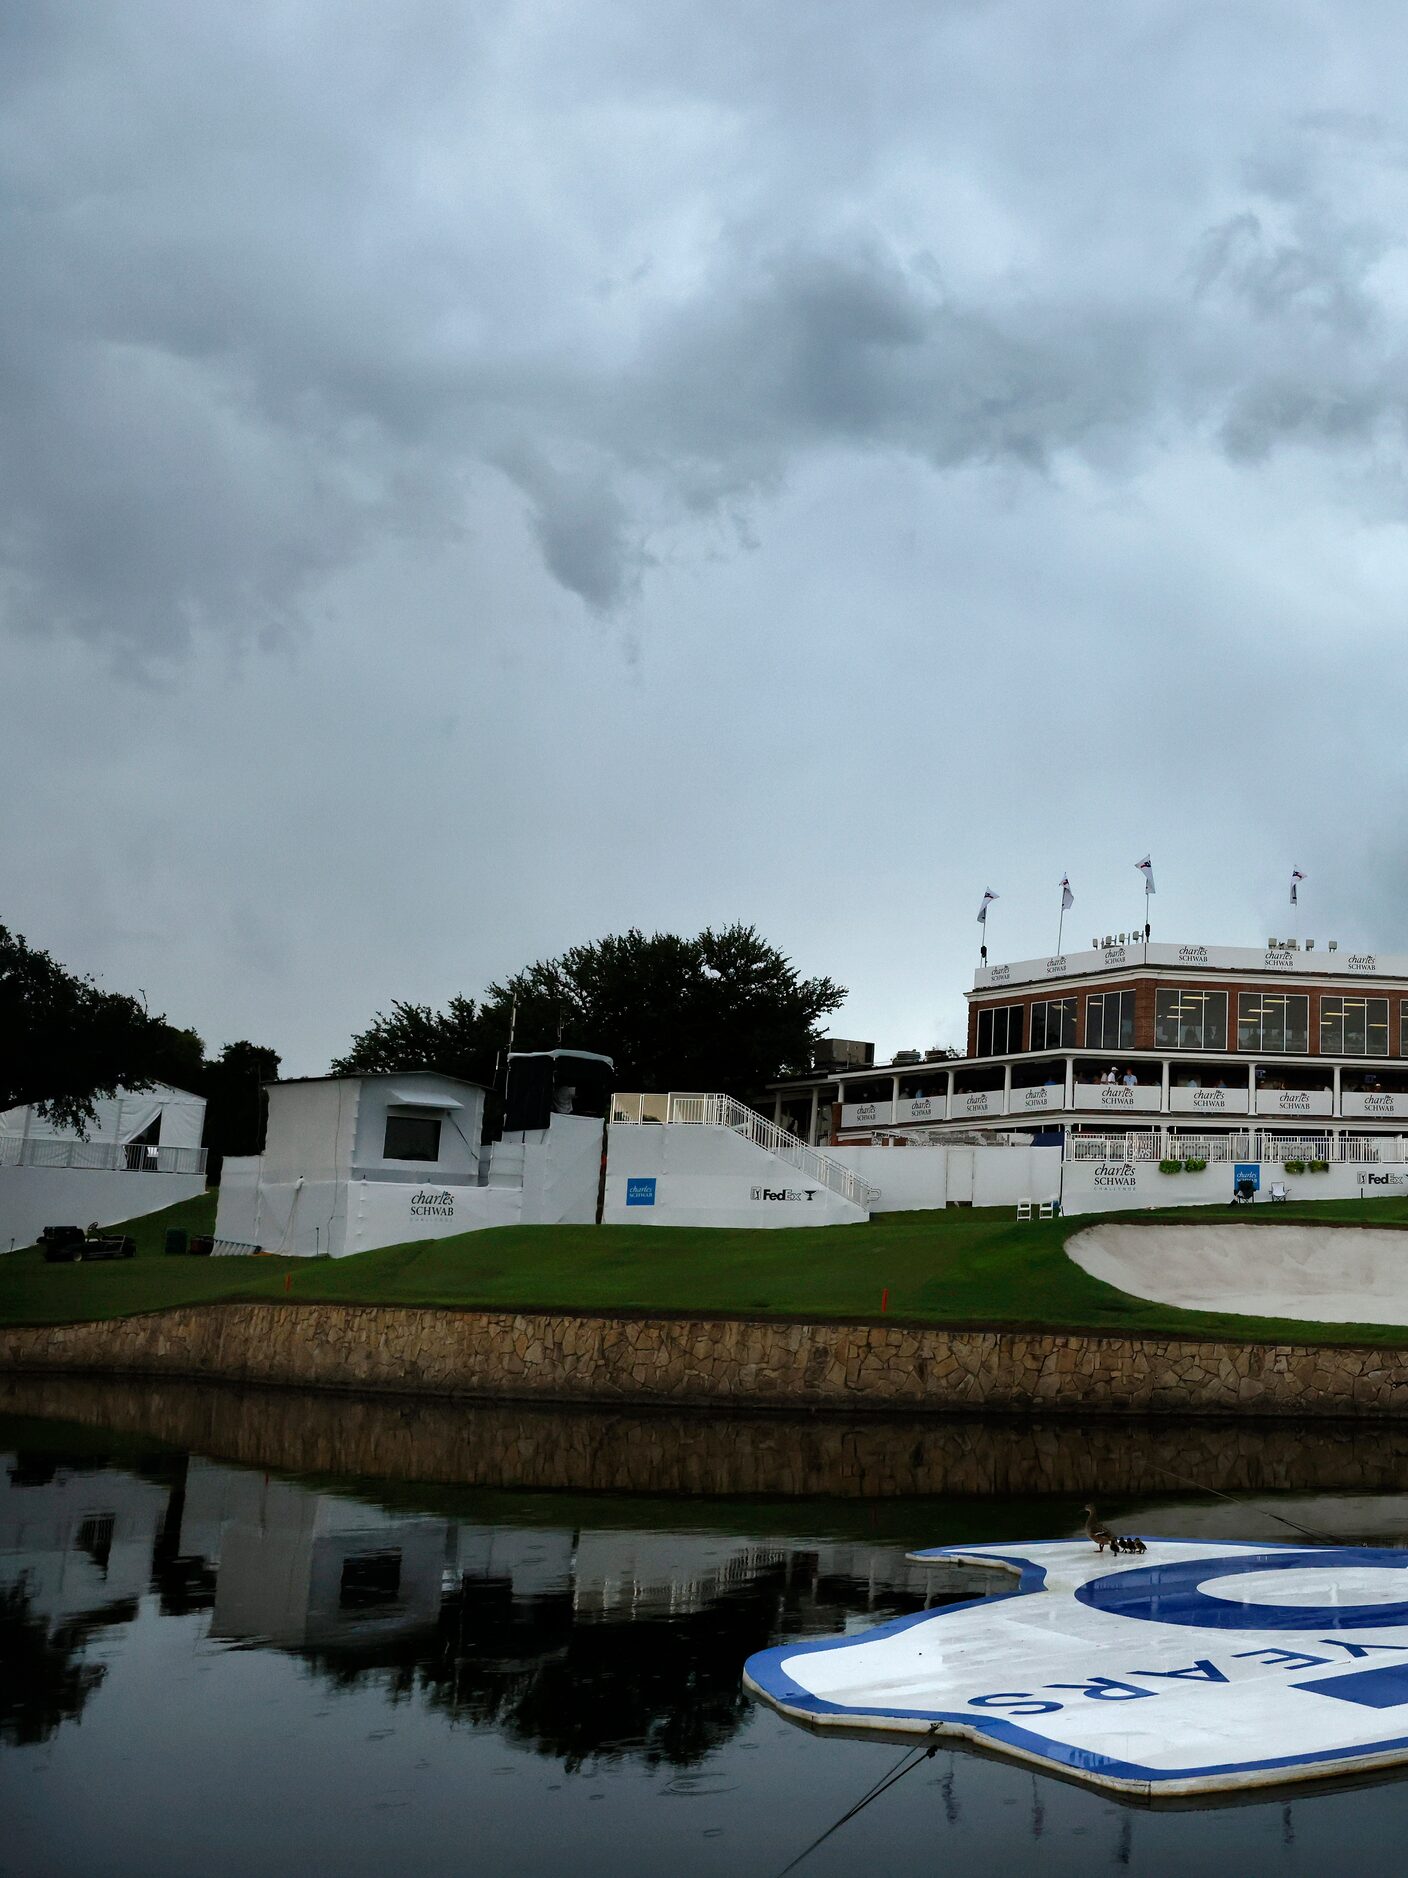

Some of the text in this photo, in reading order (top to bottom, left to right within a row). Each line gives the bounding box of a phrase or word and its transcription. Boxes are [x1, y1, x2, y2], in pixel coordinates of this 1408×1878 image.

[1179, 946, 1207, 956] charles
[1265, 951, 1293, 960] charles
[1348, 954, 1375, 964] charles
[1026, 1088, 1047, 1099] charles
[1102, 1087, 1134, 1097] charles
[1194, 1090, 1225, 1100] charles
[1280, 1092, 1310, 1102] charles
[1025, 1098, 1048, 1107] SCHWAB
[1364, 1095, 1393, 1104] charles
[1095, 1163, 1135, 1176] charles
[1094, 1177, 1136, 1185] SCHWAB
[1368, 1174, 1403, 1184] FedEx
[411, 1191, 454, 1205] charles
[763, 1189, 801, 1201] FedEx
[411, 1206, 454, 1216] SCHWAB
